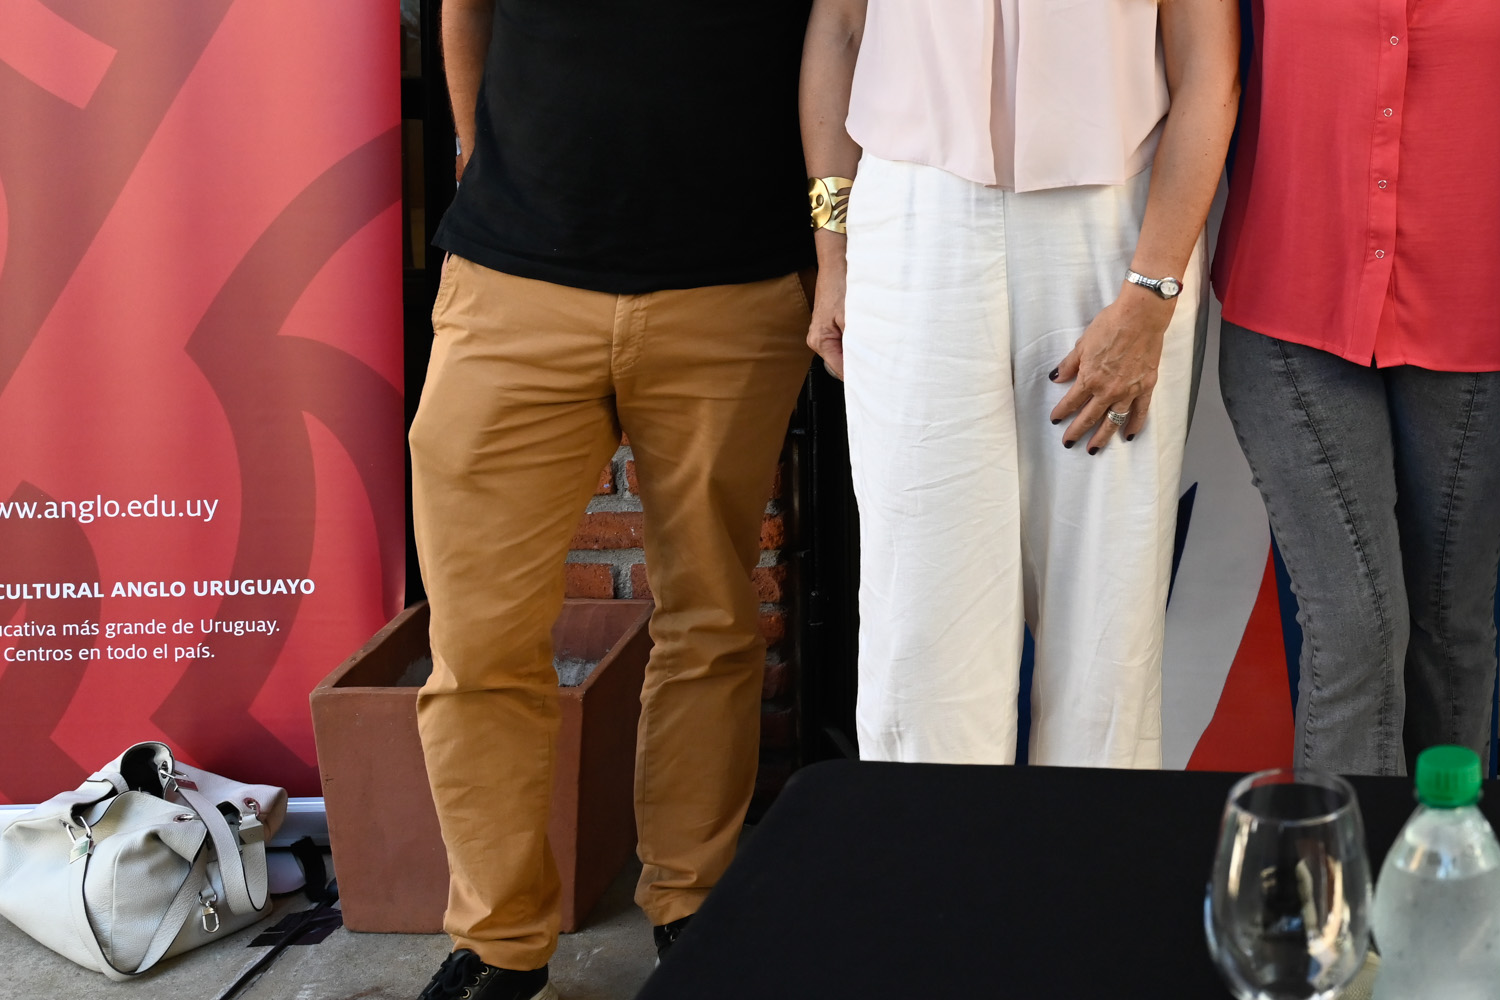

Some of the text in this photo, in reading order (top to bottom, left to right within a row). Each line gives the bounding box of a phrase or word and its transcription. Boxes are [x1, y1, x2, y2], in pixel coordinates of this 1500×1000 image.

[110, 580, 187, 598] ANGLO
[193, 578, 316, 597] URUGUAYO
[0, 618, 281, 639] cativa más grande de Uruguay.
[3, 642, 216, 663] Centros en todo el país.
